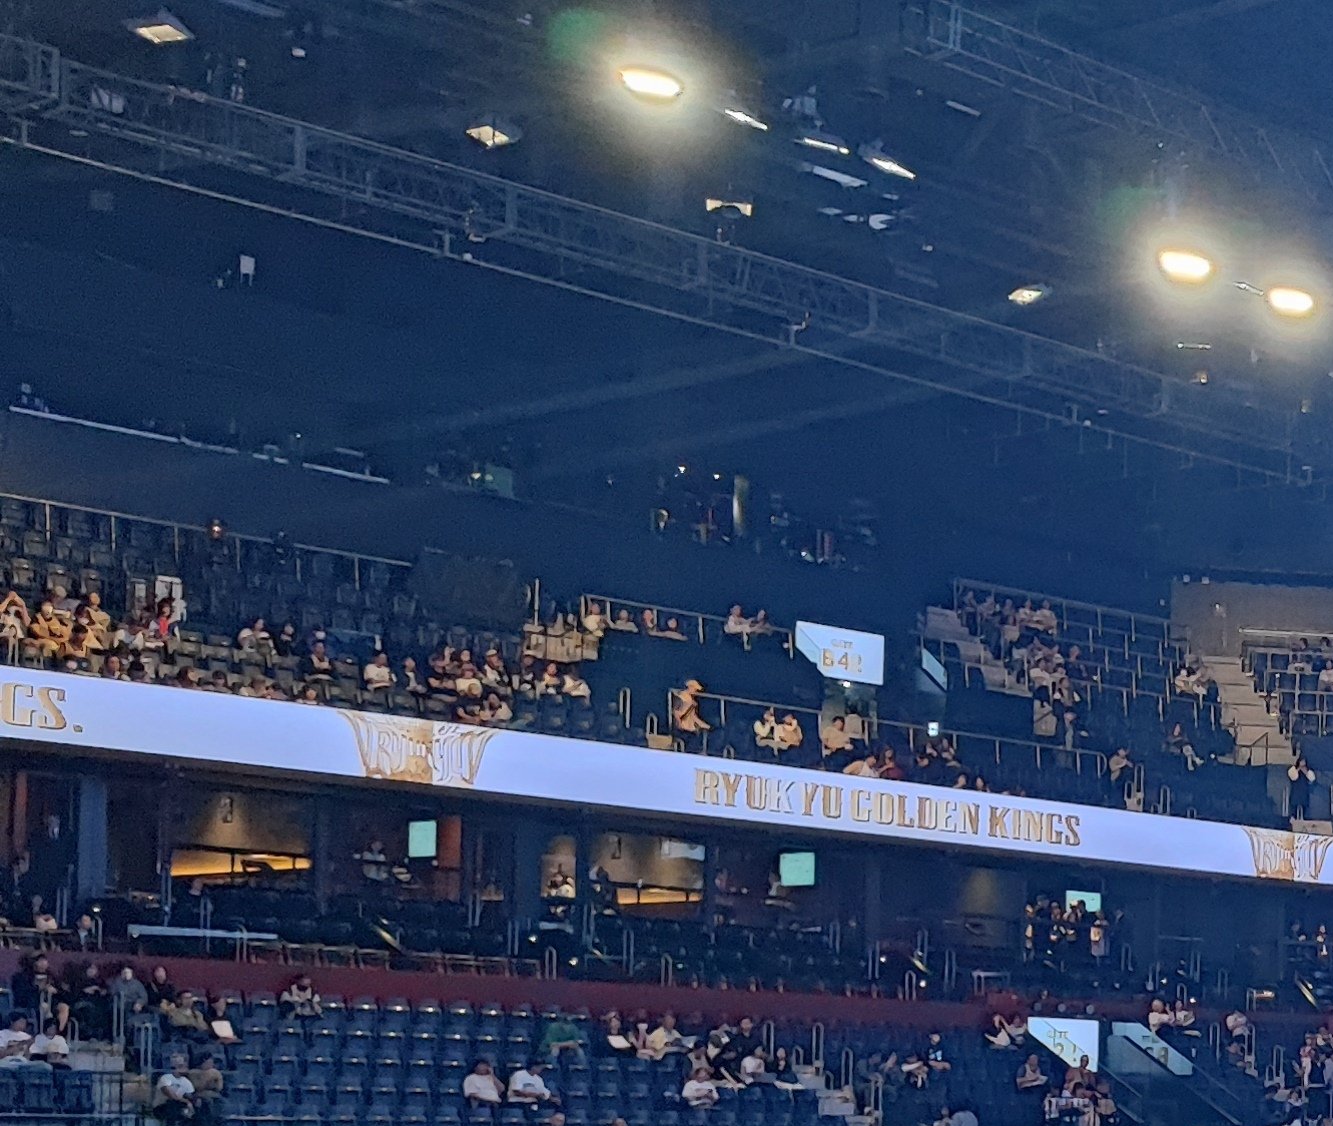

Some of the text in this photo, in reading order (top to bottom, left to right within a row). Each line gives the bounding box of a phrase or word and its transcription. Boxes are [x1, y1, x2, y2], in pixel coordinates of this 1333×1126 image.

[694, 768, 1082, 847] RYUKYU GOLDEN KINGS
